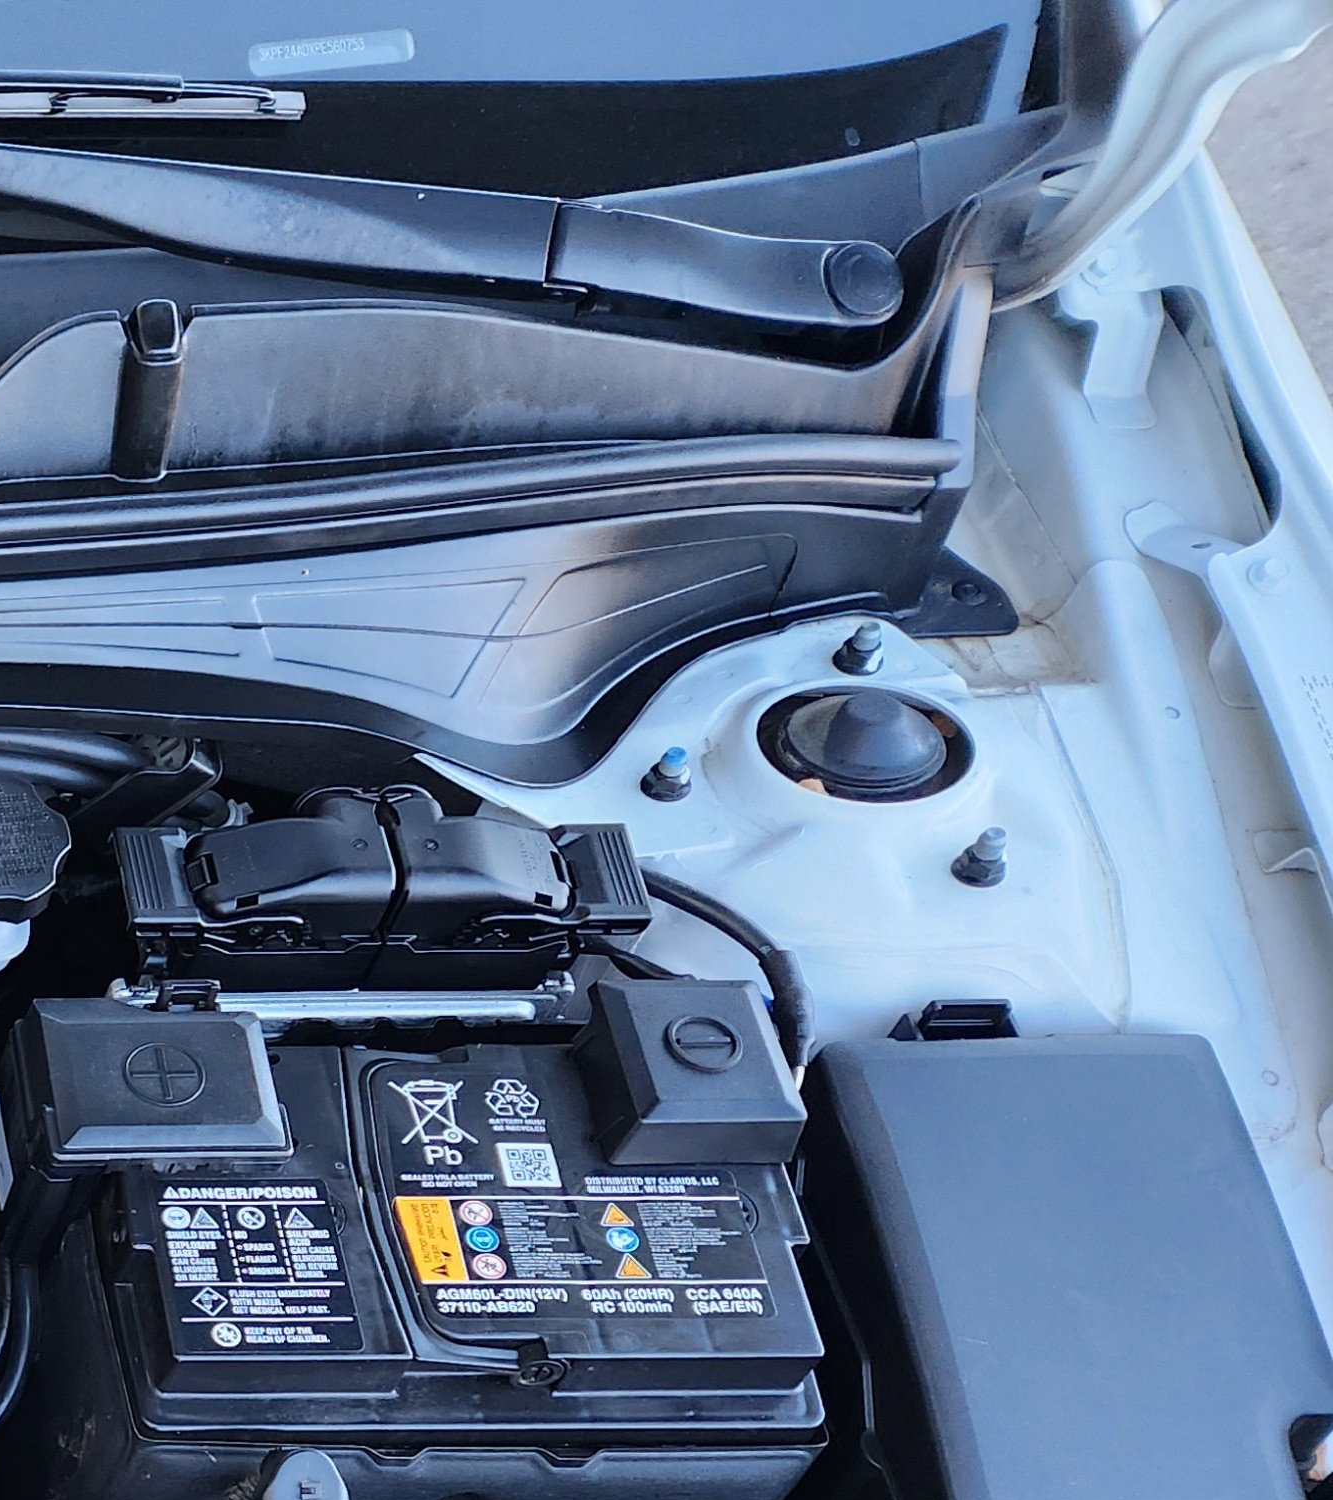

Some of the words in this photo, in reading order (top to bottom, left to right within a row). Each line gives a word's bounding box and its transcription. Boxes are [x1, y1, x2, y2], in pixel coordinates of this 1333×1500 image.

[505, 1125, 547, 1133] RECYCLED
[423, 1145, 463, 1166] Pb
[421, 1180, 434, 1188] DO
[454, 1180, 478, 1188] OPEN
[584, 1177, 644, 1185] DISTRIBUTED
[644, 1177, 657, 1185] BY
[658, 1177, 701, 1186] CLARIOS,
[701, 1177, 719, 1185] LLC
[178, 1186, 318, 1200] DANGER/POISON
[234, 1230, 248, 1239] NO
[167, 1241, 217, 1249] EXPLOSIVE
[245, 1255, 277, 1263] FLAMES
[228, 1289, 256, 1298] FLUSH
[256, 1289, 277, 1298] EYES
[436, 1288, 568, 1302] AGM60L-DIN(12V)
[581, 1288, 621, 1300] 60Ah
[624, 1287, 675, 1302] (20HR)
[685, 1288, 721, 1300] CCA
[722, 1288, 763, 1300] 640A
[232, 1306, 249, 1314] GET
[249, 1306, 286, 1314] MEDICAL
[285, 1306, 308, 1314] HELP
[438, 1301, 535, 1313] 37110-AB620
[591, 1301, 616, 1313] RC
[619, 1301, 673, 1313] 100min
[693, 1301, 763, 1316] (SAE/EN)
[244, 1326, 265, 1335] KEEP
[266, 1327, 283, 1335] OUT
[283, 1327, 295, 1335] OF
[295, 1326, 313, 1335] THE
[245, 1335, 274, 1343] REACH
[274, 1335, 286, 1343] OF
